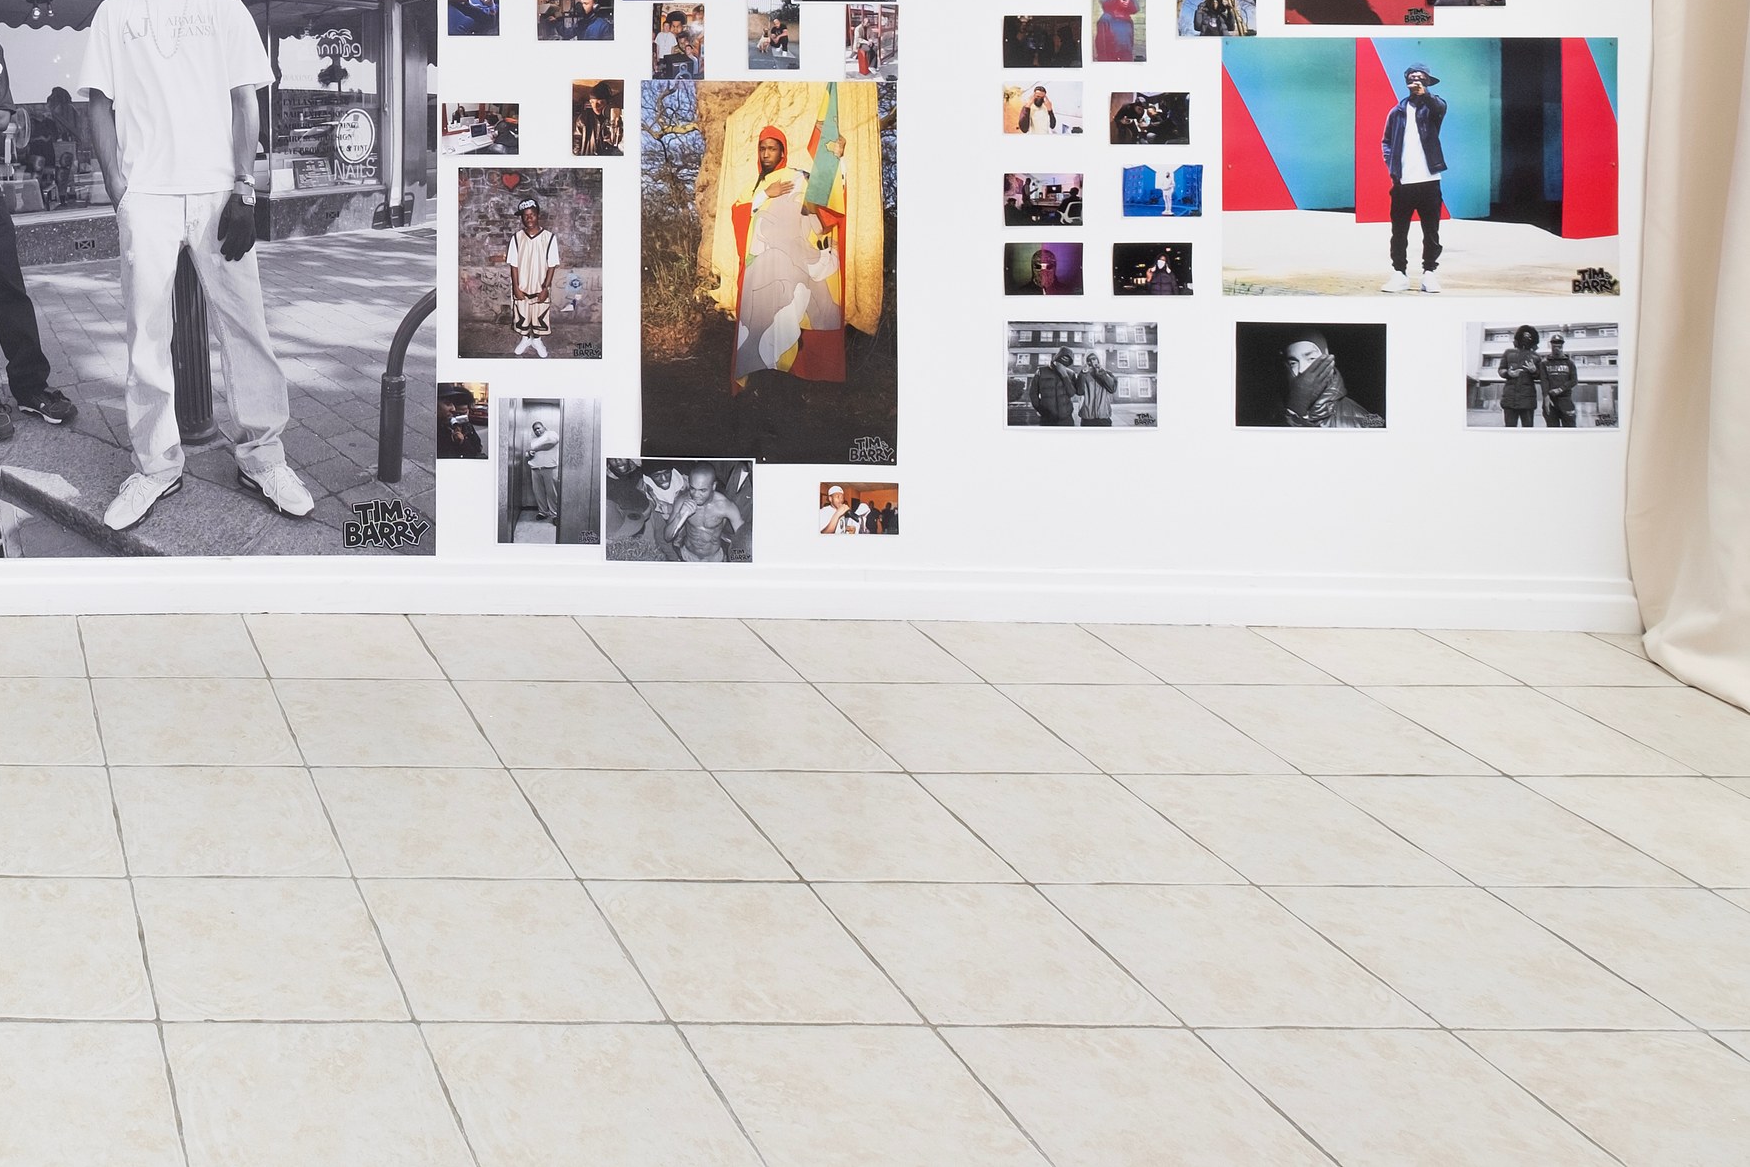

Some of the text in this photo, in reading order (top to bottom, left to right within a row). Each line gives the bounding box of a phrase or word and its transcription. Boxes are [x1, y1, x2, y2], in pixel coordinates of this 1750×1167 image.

[353, 144, 368, 152] TINT
[333, 156, 377, 181] NAILS
[1571, 278, 1619, 294] BARRY
[849, 446, 895, 462] BARRY
[342, 519, 431, 548] BARRY
